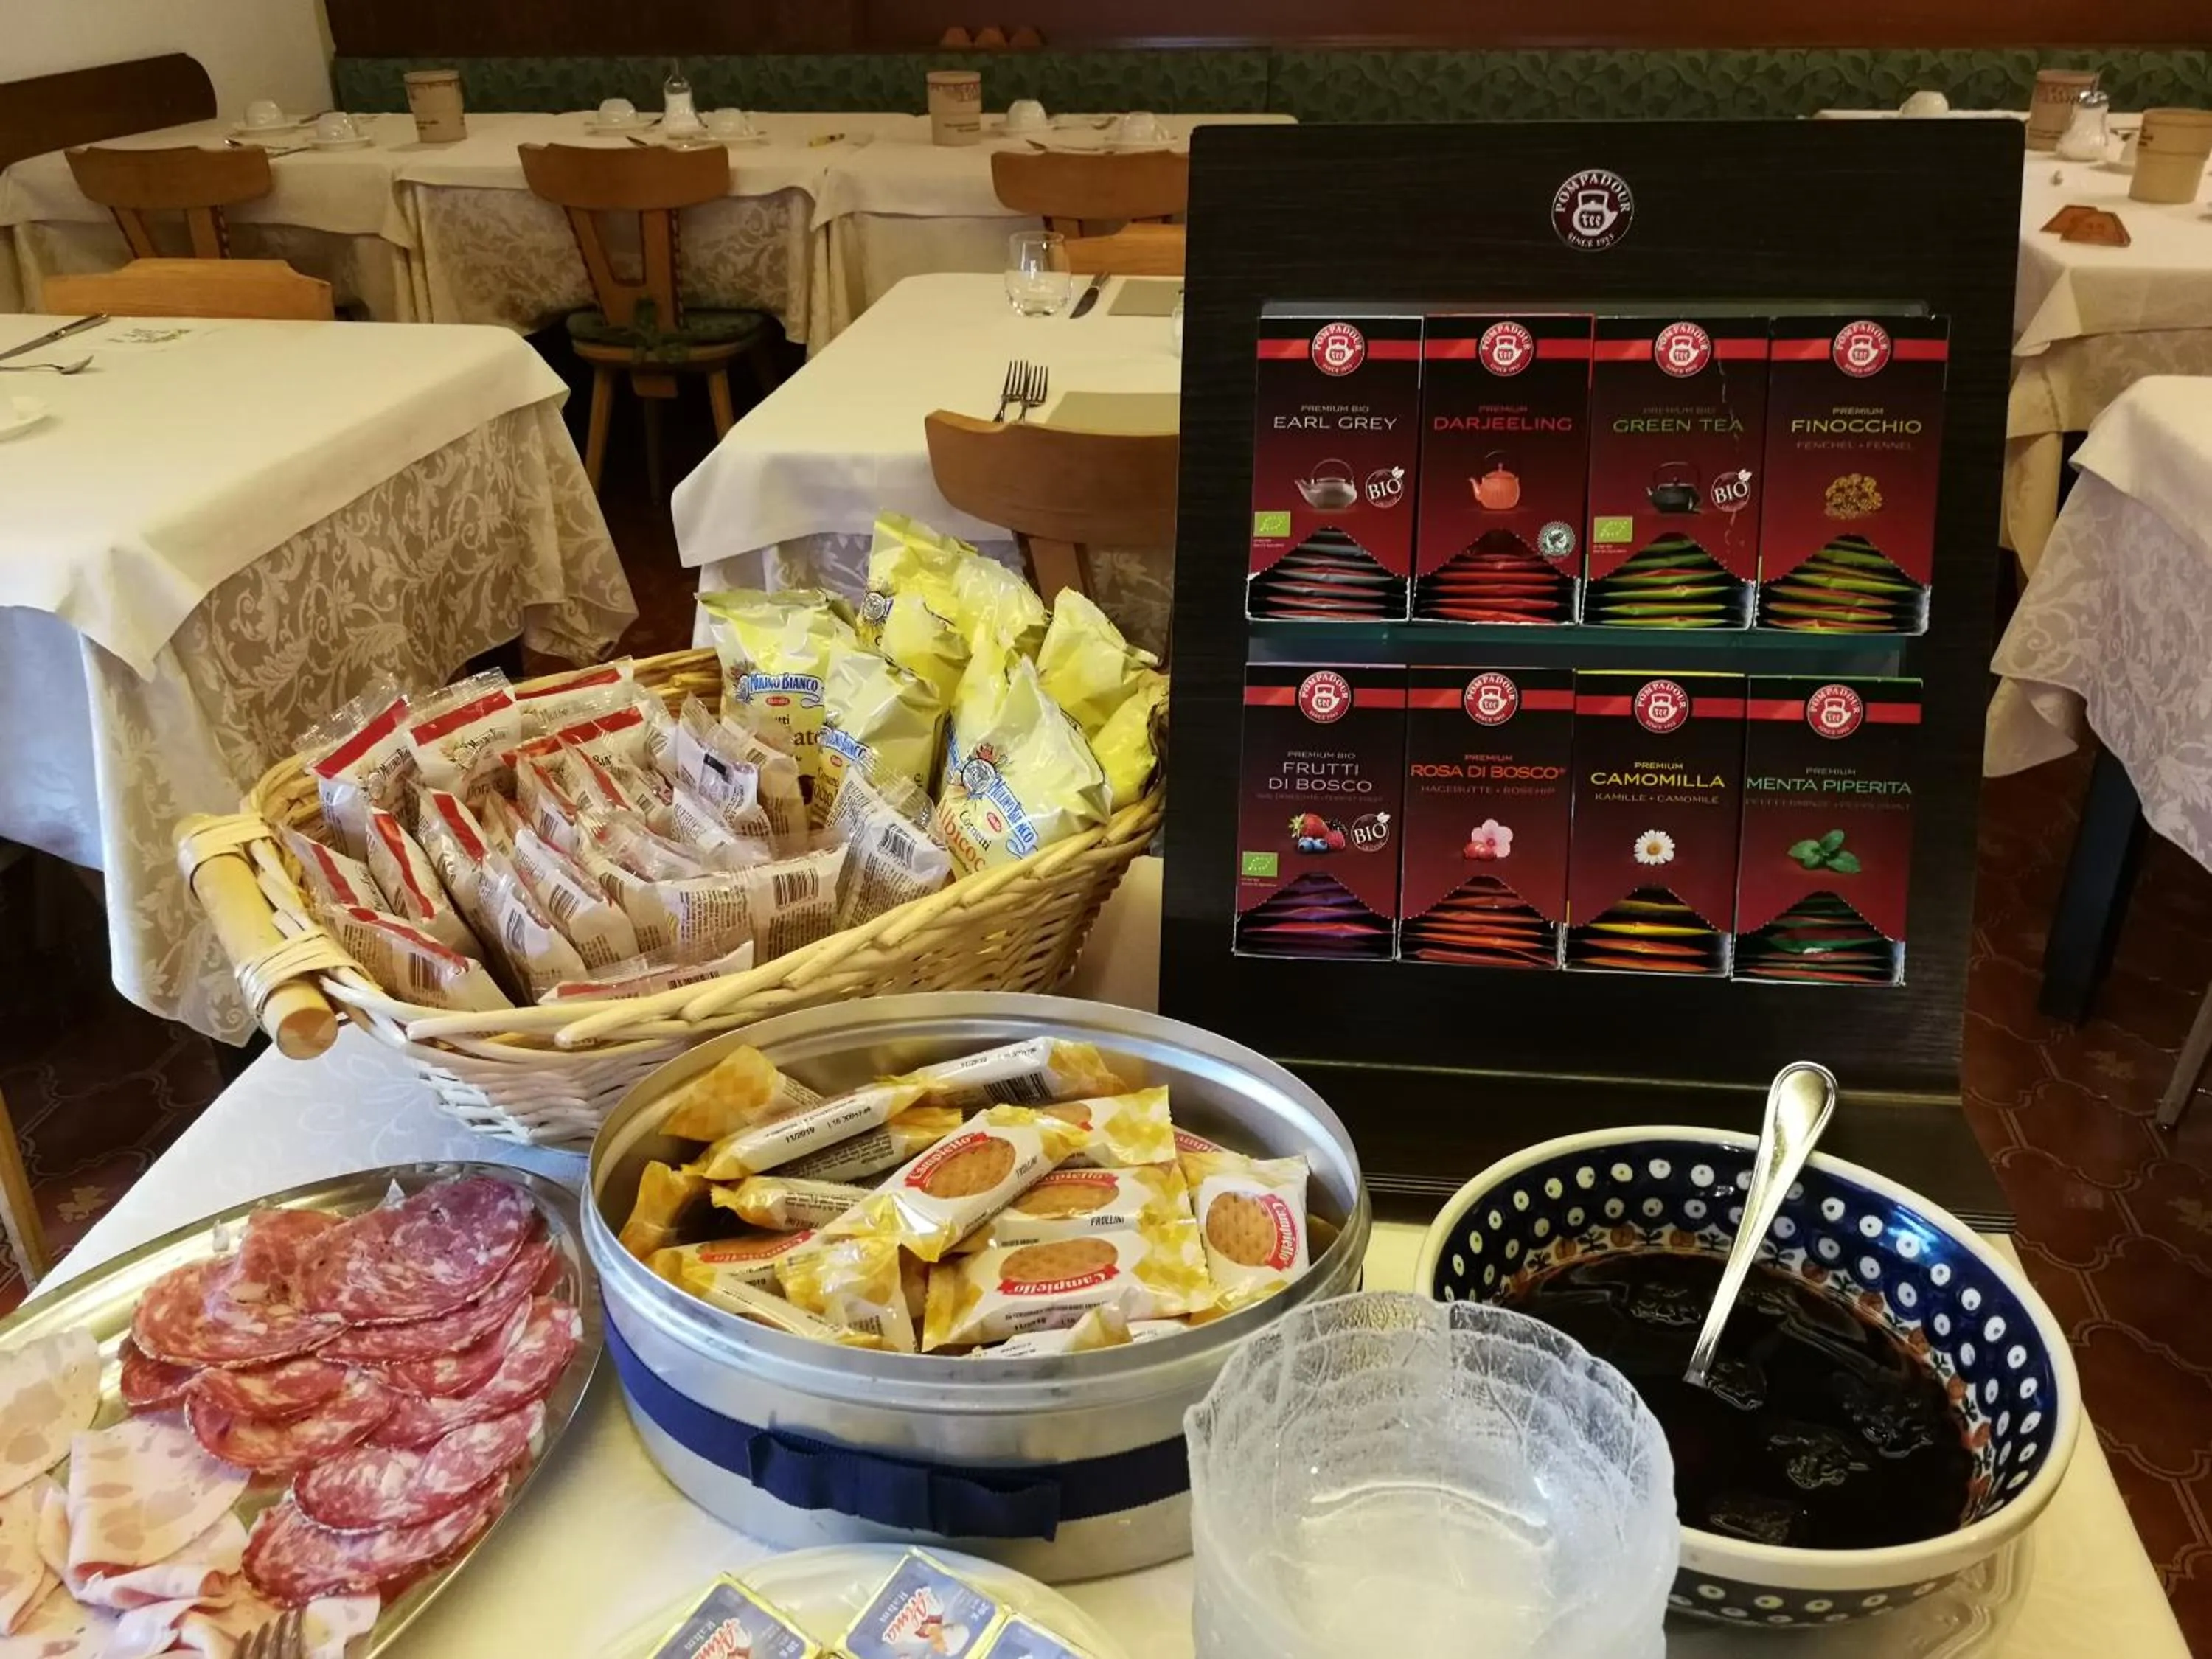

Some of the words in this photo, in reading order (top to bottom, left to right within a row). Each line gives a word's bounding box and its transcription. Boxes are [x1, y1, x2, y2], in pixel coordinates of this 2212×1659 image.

[1555, 173, 1630, 212] POMPADOUR
[1314, 324, 1362, 351] POMPADOUR
[1482, 324, 1531, 350] POMPADOUR
[1833, 407, 1884, 415] PREMIUM
[1273, 416, 1330, 429] EARL
[1338, 417, 1397, 430] GREY
[1433, 417, 1572, 431] DARJEELING
[1613, 419, 1691, 433] GREEN
[1698, 419, 1744, 433] TEA
[1792, 419, 1922, 434] FINOCCHIO
[1368, 479, 1401, 500] BIO
[1714, 481, 1748, 504] BIO
[782, 672, 818, 692] BIANCO
[1301, 673, 1349, 699] POMPADOUR
[1467, 675, 1515, 700] POMPADOUR
[1637, 682, 1686, 708] POMPADOUR
[1809, 686, 1860, 714] POMPADOUR
[1283, 762, 1359, 775] FRUTTI
[1411, 765, 1464, 777] ROSA
[1467, 765, 1485, 777] DI
[1634, 762, 1683, 770] PREMIUM
[1806, 767, 1856, 775] PREMIUM
[1269, 777, 1288, 790] DI
[1295, 778, 1372, 793] BOSCO
[1590, 772, 1725, 787] CAMOMILLA
[1747, 777, 1818, 791] MENTA
[1823, 779, 1912, 795] PIPERITA
[1595, 793, 1646, 802] KAMILLE
[1657, 794, 1719, 804] CAMOMILE
[1354, 822, 1386, 844] BIO
[1091, 1216, 1124, 1227] FROLLINI
[1273, 1202, 1296, 1262] Campiello
[1013, 1272, 1106, 1293] Campiello
[692, 1617, 741, 1659] Alm
